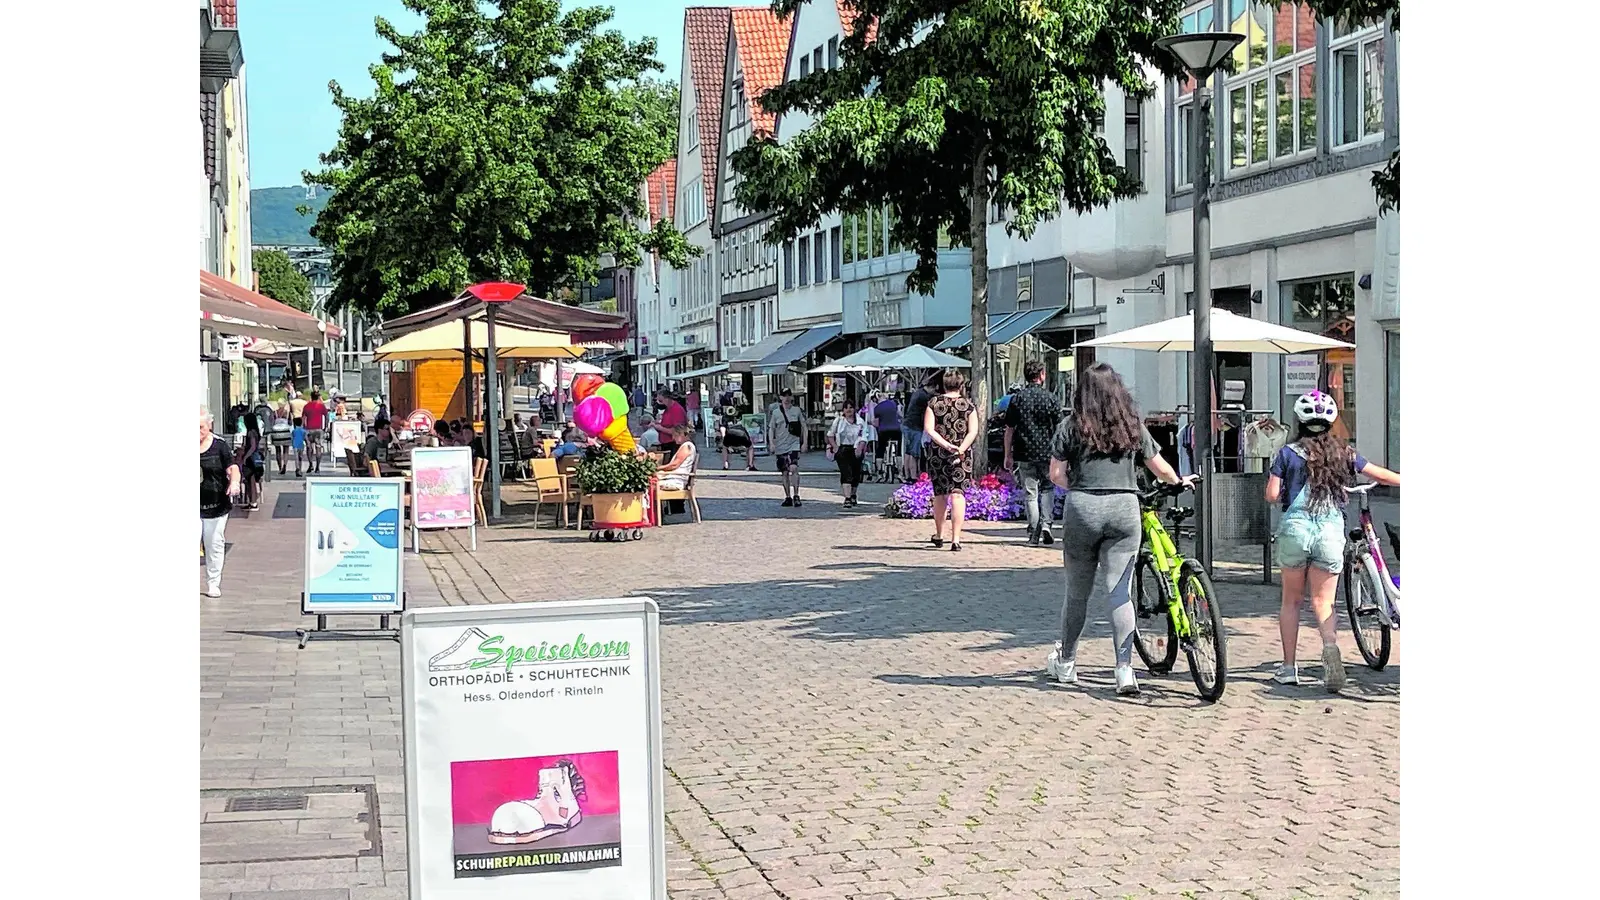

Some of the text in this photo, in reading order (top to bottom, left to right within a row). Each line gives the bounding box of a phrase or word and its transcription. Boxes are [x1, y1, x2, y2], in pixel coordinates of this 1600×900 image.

[1116, 296, 1126, 305] 26
[470, 633, 631, 673] Speisekorn
[428, 665, 631, 687] ORTHOPÄDIE SCHUHTECHNIK
[463, 685, 604, 703] Hess. Oldendorf Rinteln
[456, 847, 620, 872] SCHUHREPARATURANNAHME
